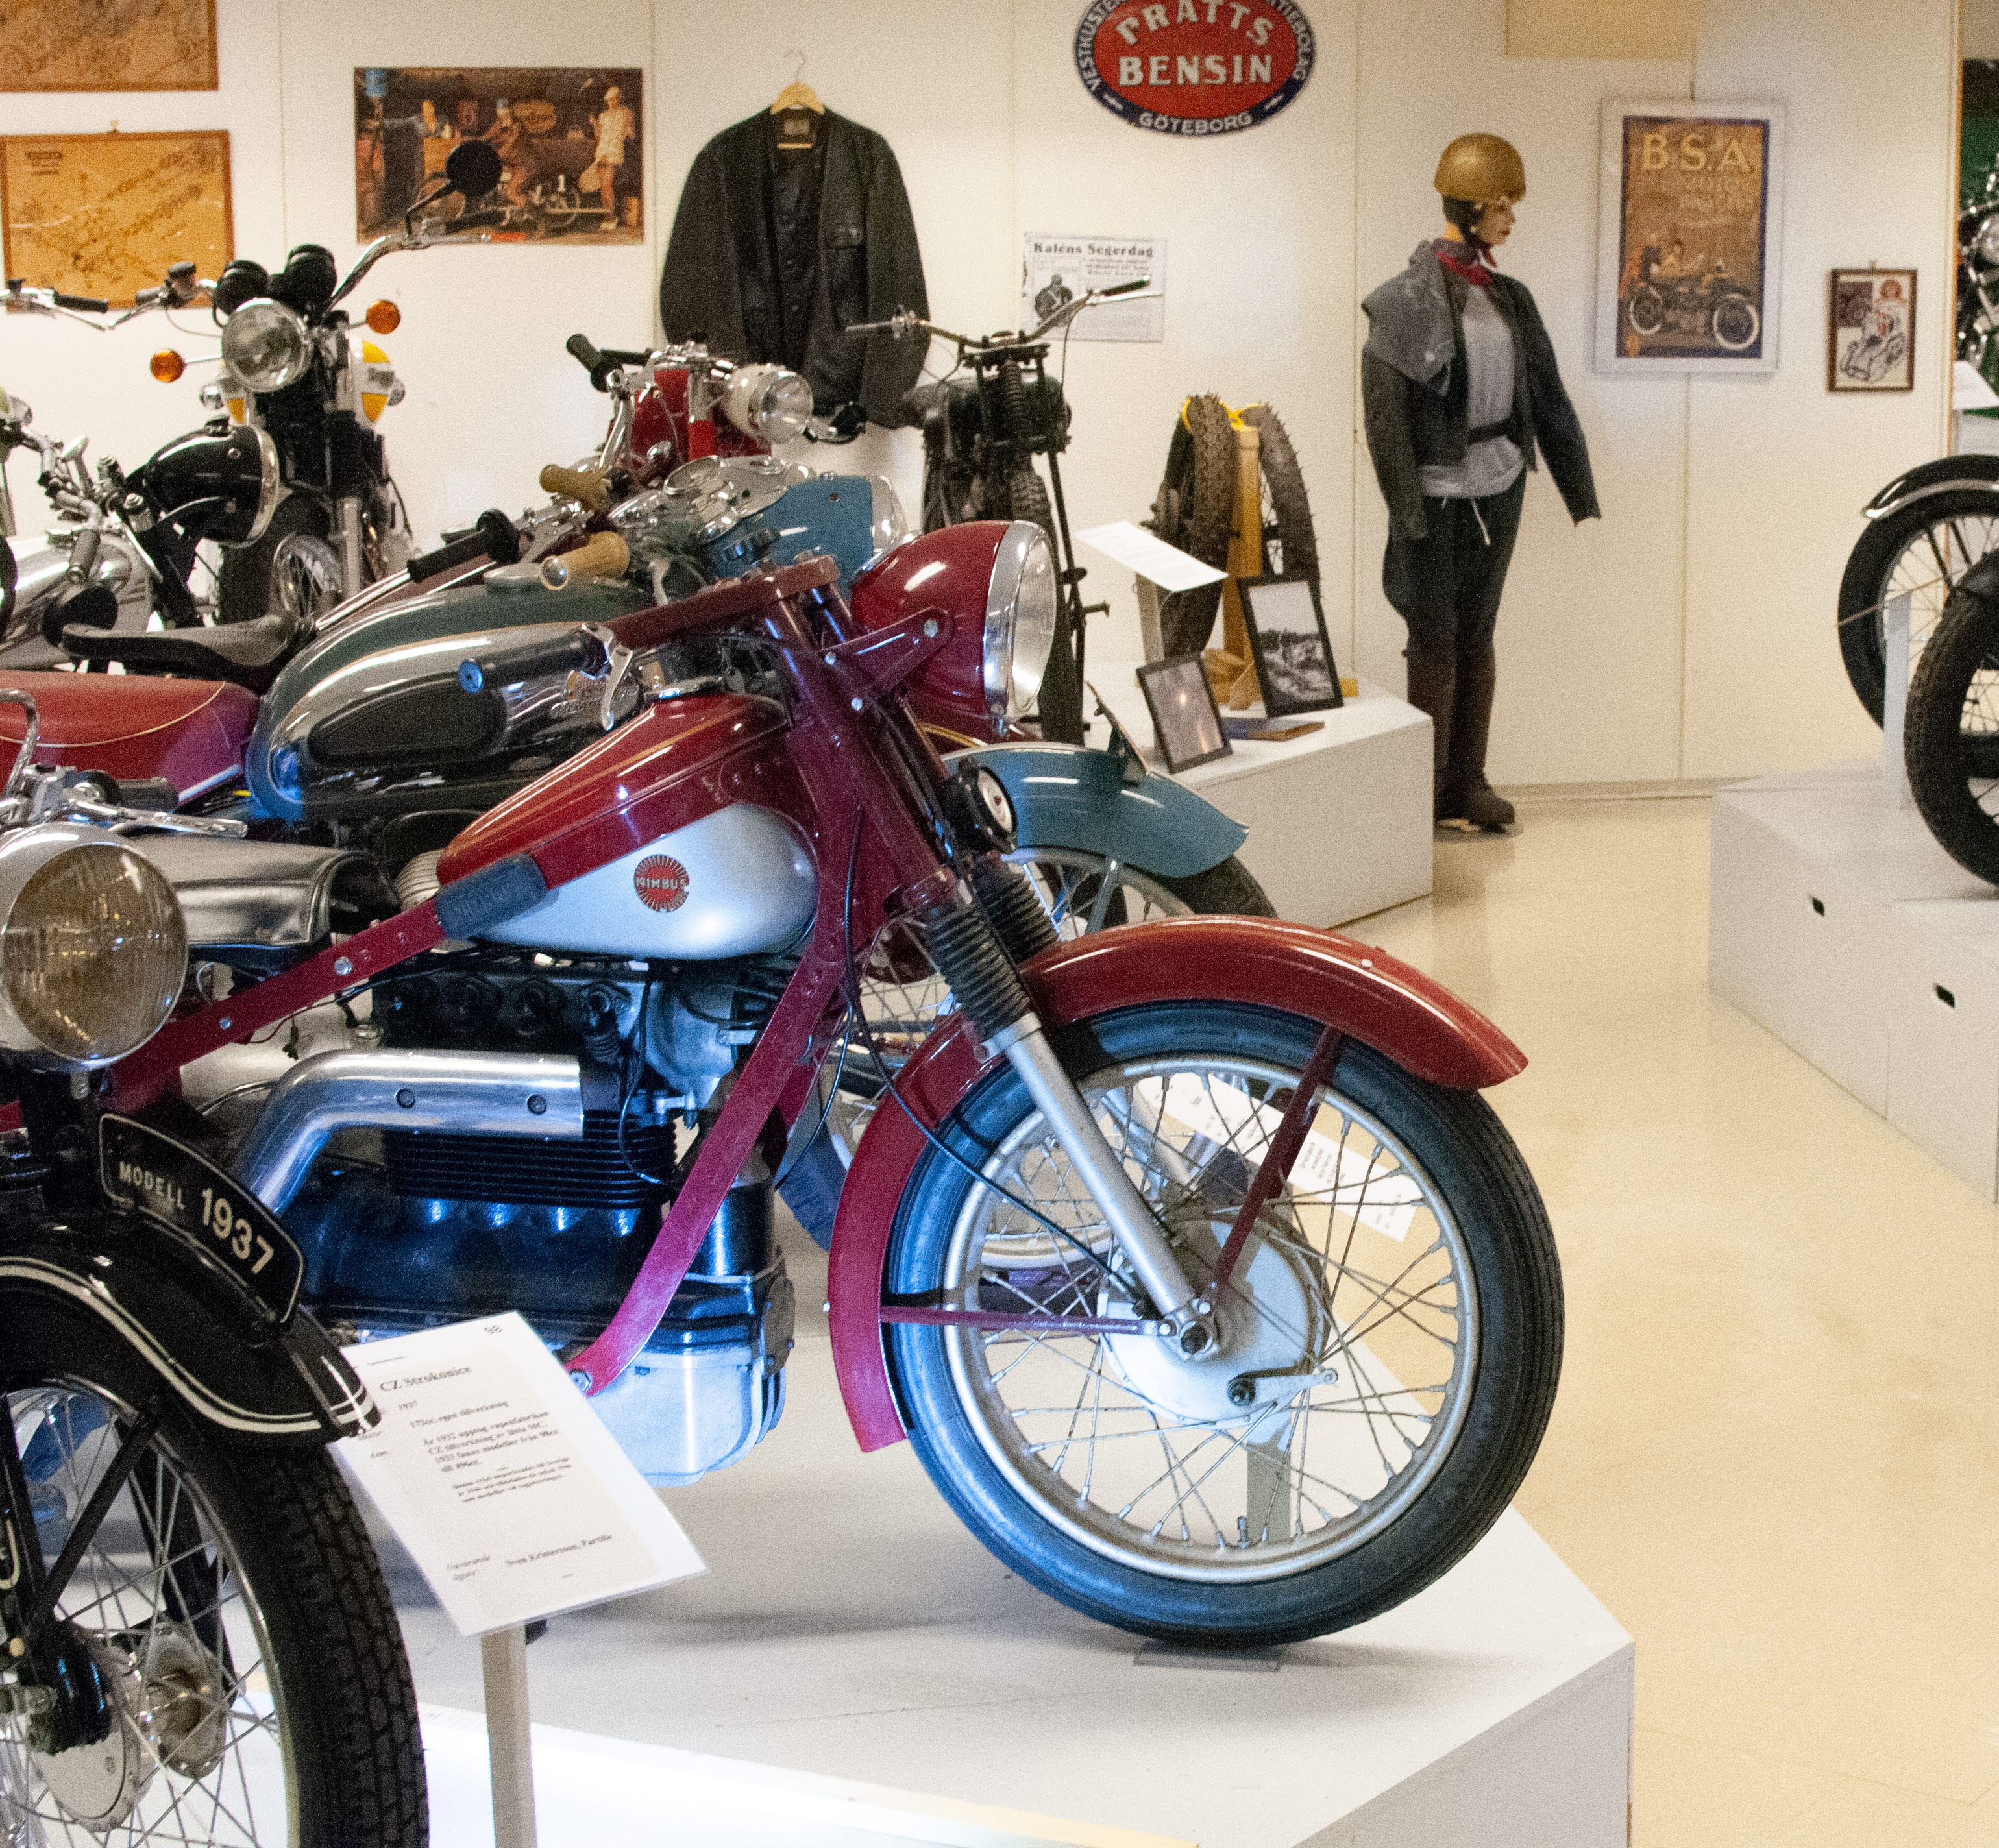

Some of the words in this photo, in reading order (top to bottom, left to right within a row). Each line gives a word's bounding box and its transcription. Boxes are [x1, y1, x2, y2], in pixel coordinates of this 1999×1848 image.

[1115, 0, 1274, 47] PRATTS
[1118, 55, 1273, 86] BENSIN
[1139, 111, 1254, 134] GÖTEBORG
[1034, 242, 1082, 254] Kaléns
[1087, 243, 1153, 258] Segerdag
[119, 1161, 185, 1210] MODELL
[202, 1188, 275, 1274] 1937
[380, 1380, 402, 1391] CZ
